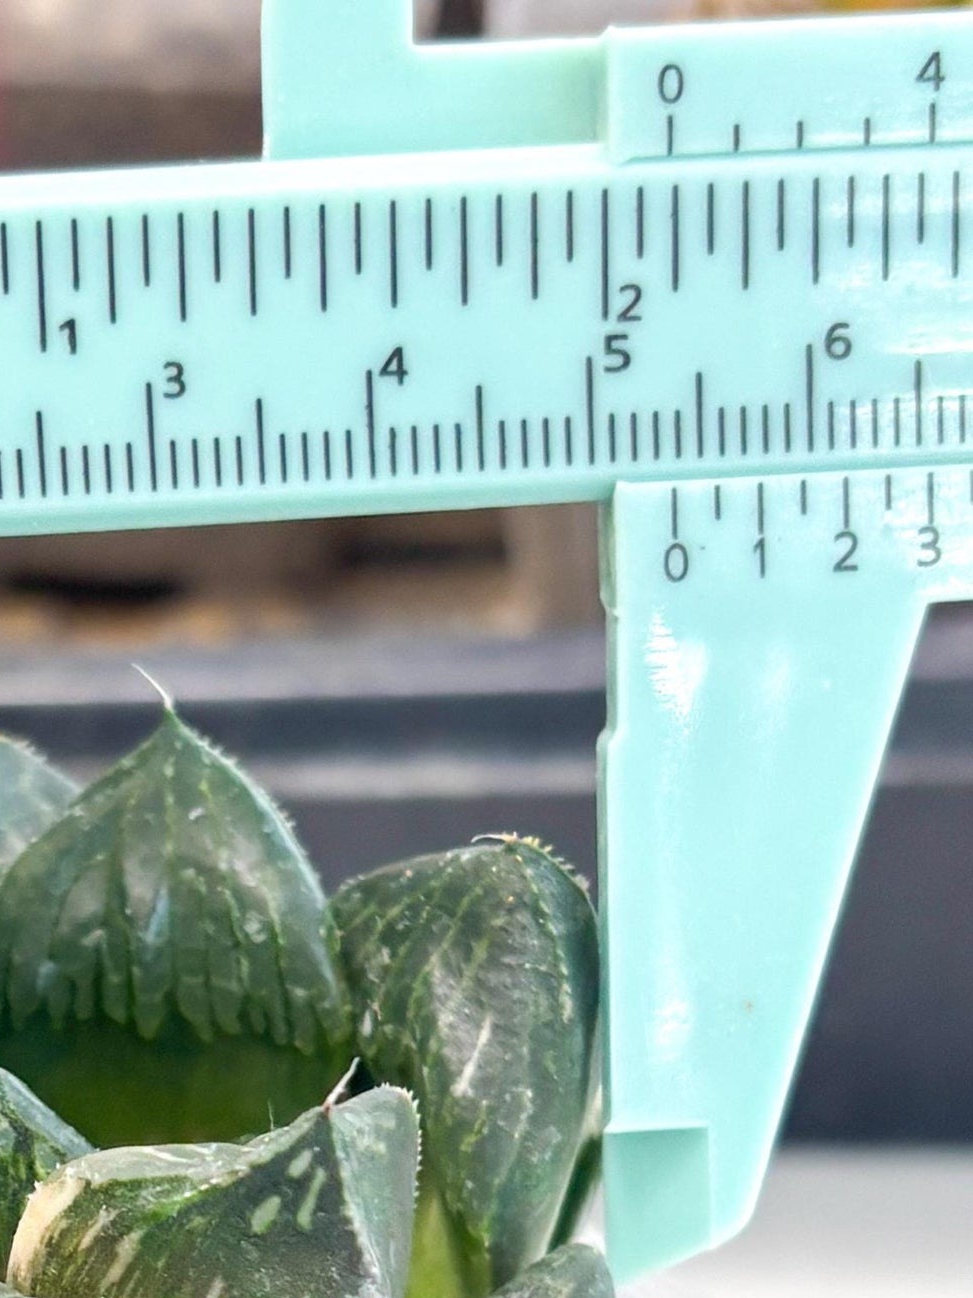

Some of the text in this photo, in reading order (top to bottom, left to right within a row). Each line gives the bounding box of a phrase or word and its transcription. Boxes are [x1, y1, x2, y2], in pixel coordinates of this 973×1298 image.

[656, 50, 948, 106] 0 4
[57, 316, 80, 357] 1
[615, 282, 645, 325] 2
[161, 358, 189, 402] 3
[376, 344, 411, 388] 4
[602, 330, 635, 376] 5
[822, 320, 855, 363] 6
[661, 524, 944, 586] 0 1 2 3
